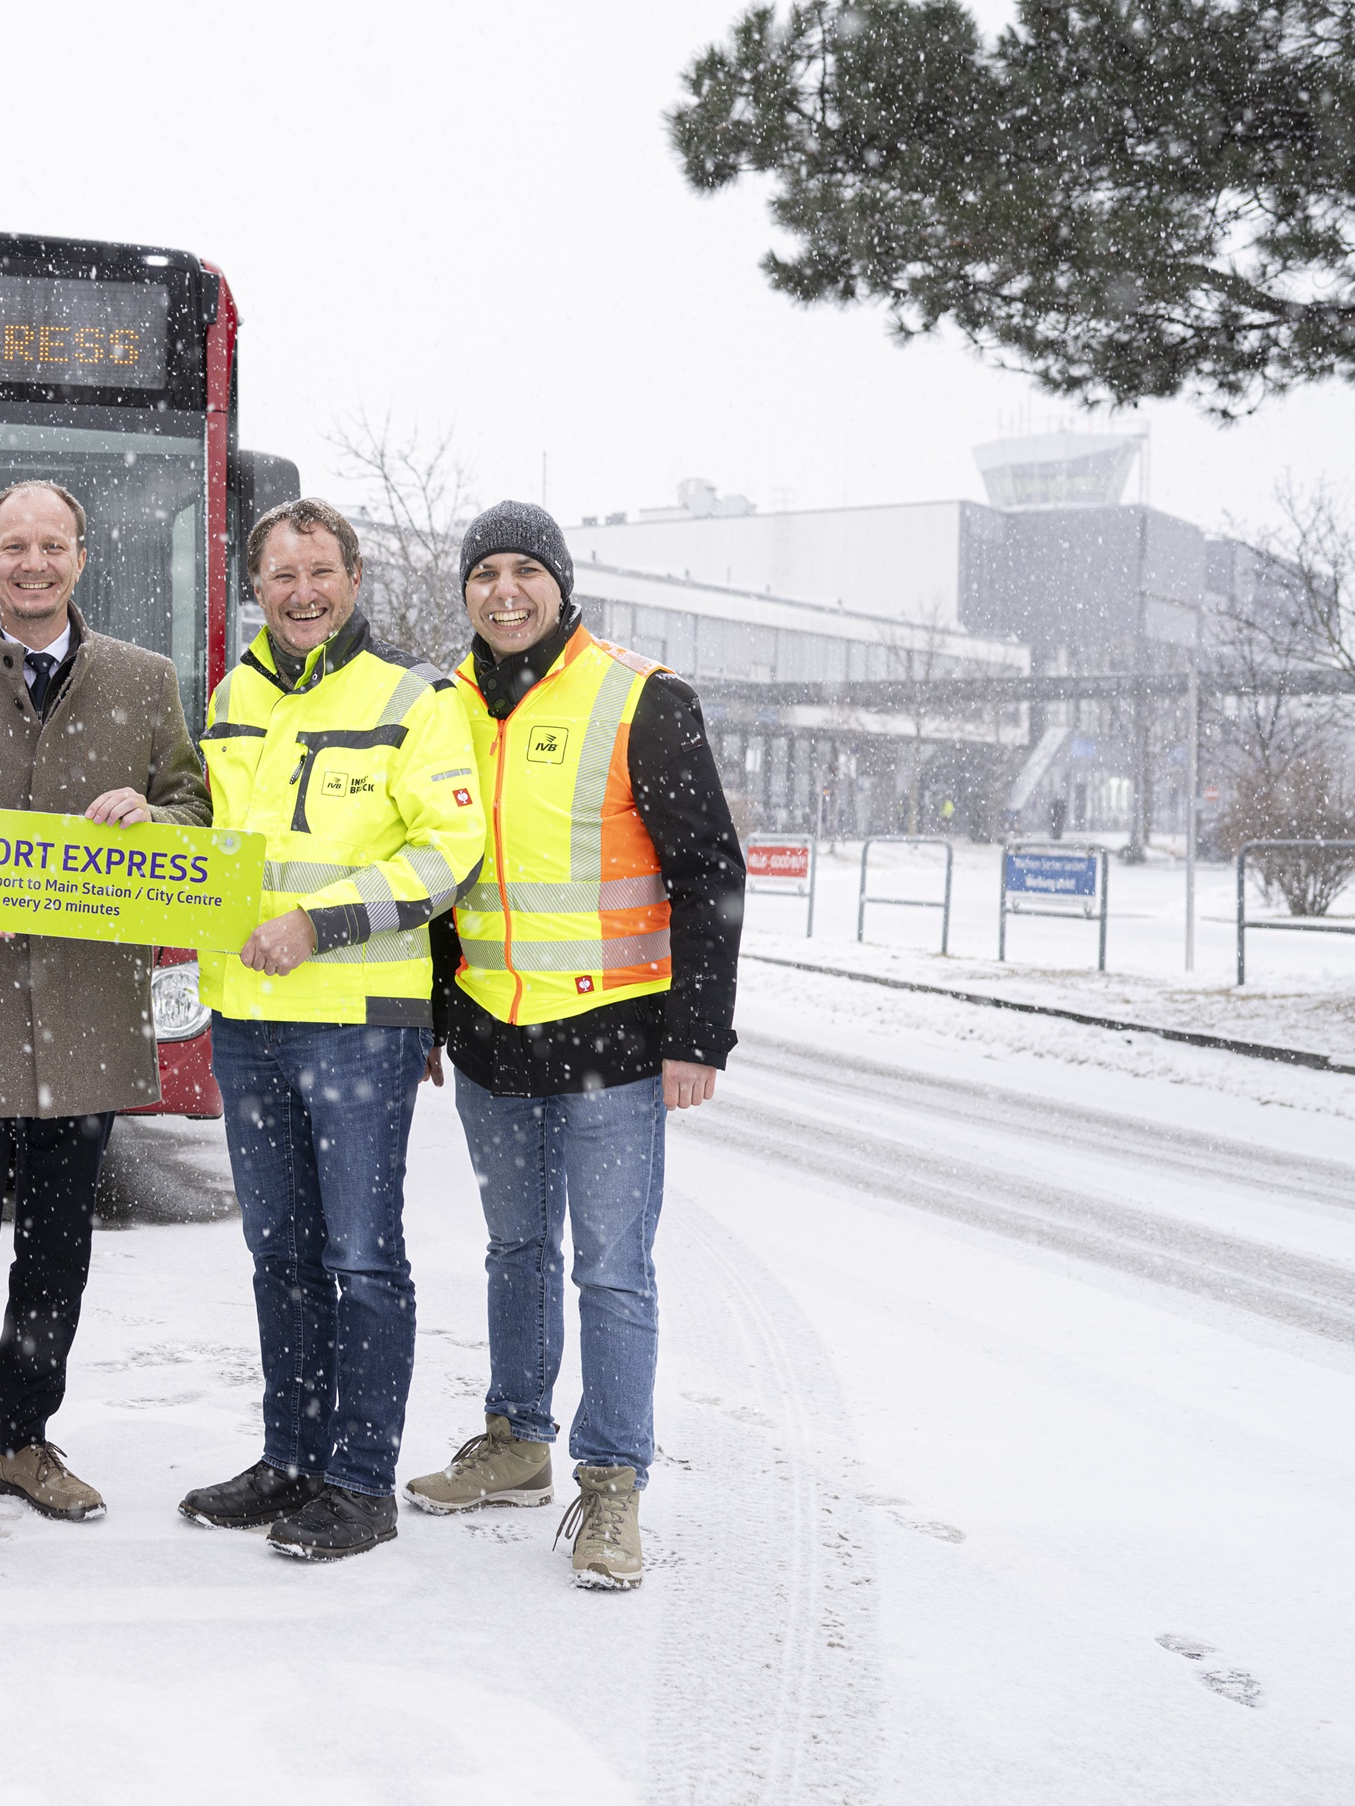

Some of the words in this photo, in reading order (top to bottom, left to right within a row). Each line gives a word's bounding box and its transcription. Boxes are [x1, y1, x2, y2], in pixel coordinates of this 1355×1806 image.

[534, 742, 558, 752] IVB
[62, 844, 209, 883] EXPRESS
[27, 878, 42, 890] to
[45, 879, 78, 894] Main
[82, 882, 132, 898] Station
[135, 887, 144, 899] /
[146, 888, 174, 905] City
[177, 891, 223, 907] Centre
[2, 896, 41, 912] every
[43, 898, 62, 911] 20
[65, 901, 120, 916] minutes
